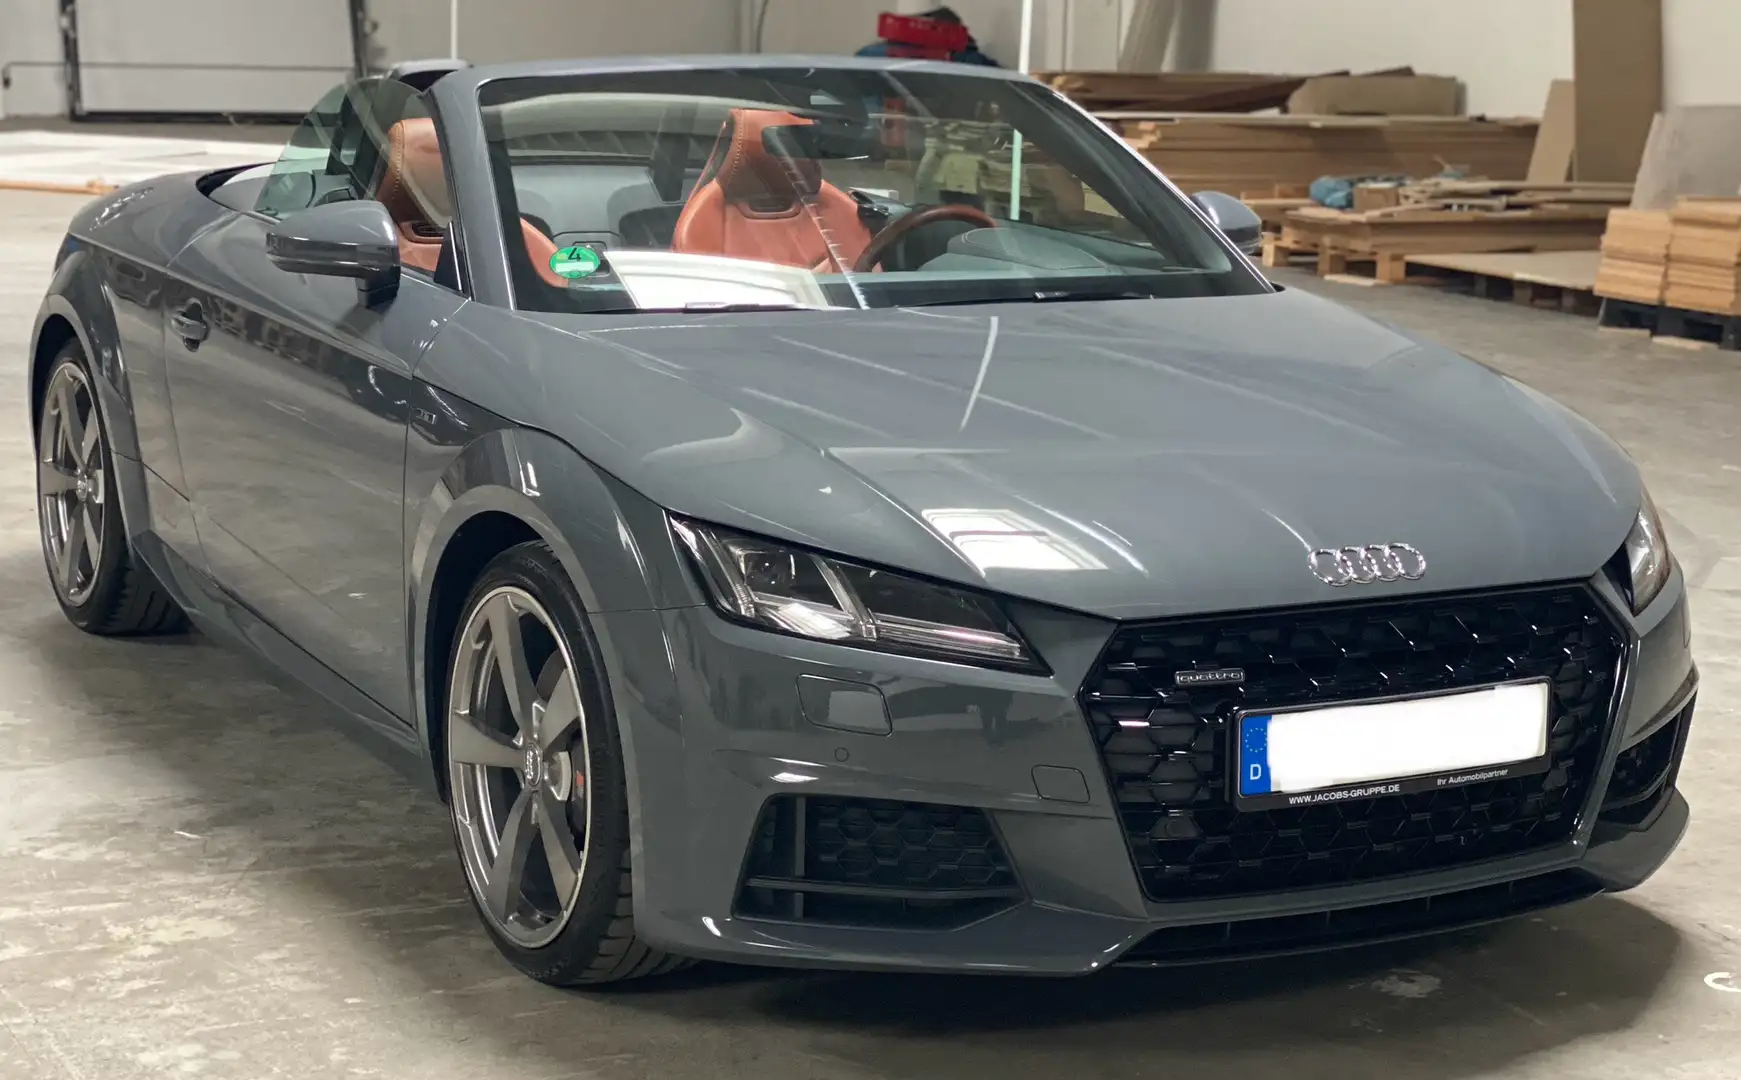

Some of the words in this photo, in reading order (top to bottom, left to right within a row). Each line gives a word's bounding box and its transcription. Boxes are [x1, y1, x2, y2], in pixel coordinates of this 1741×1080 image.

[568, 247, 582, 261] 4
[1180, 671, 1240, 684] quattro
[1250, 763, 1262, 780] D
[1436, 778, 1447, 786] Ihr
[1448, 769, 1509, 784] Automobilpartner
[1288, 783, 1400, 805] WWW.JACOBS-GRUPPE.DE
